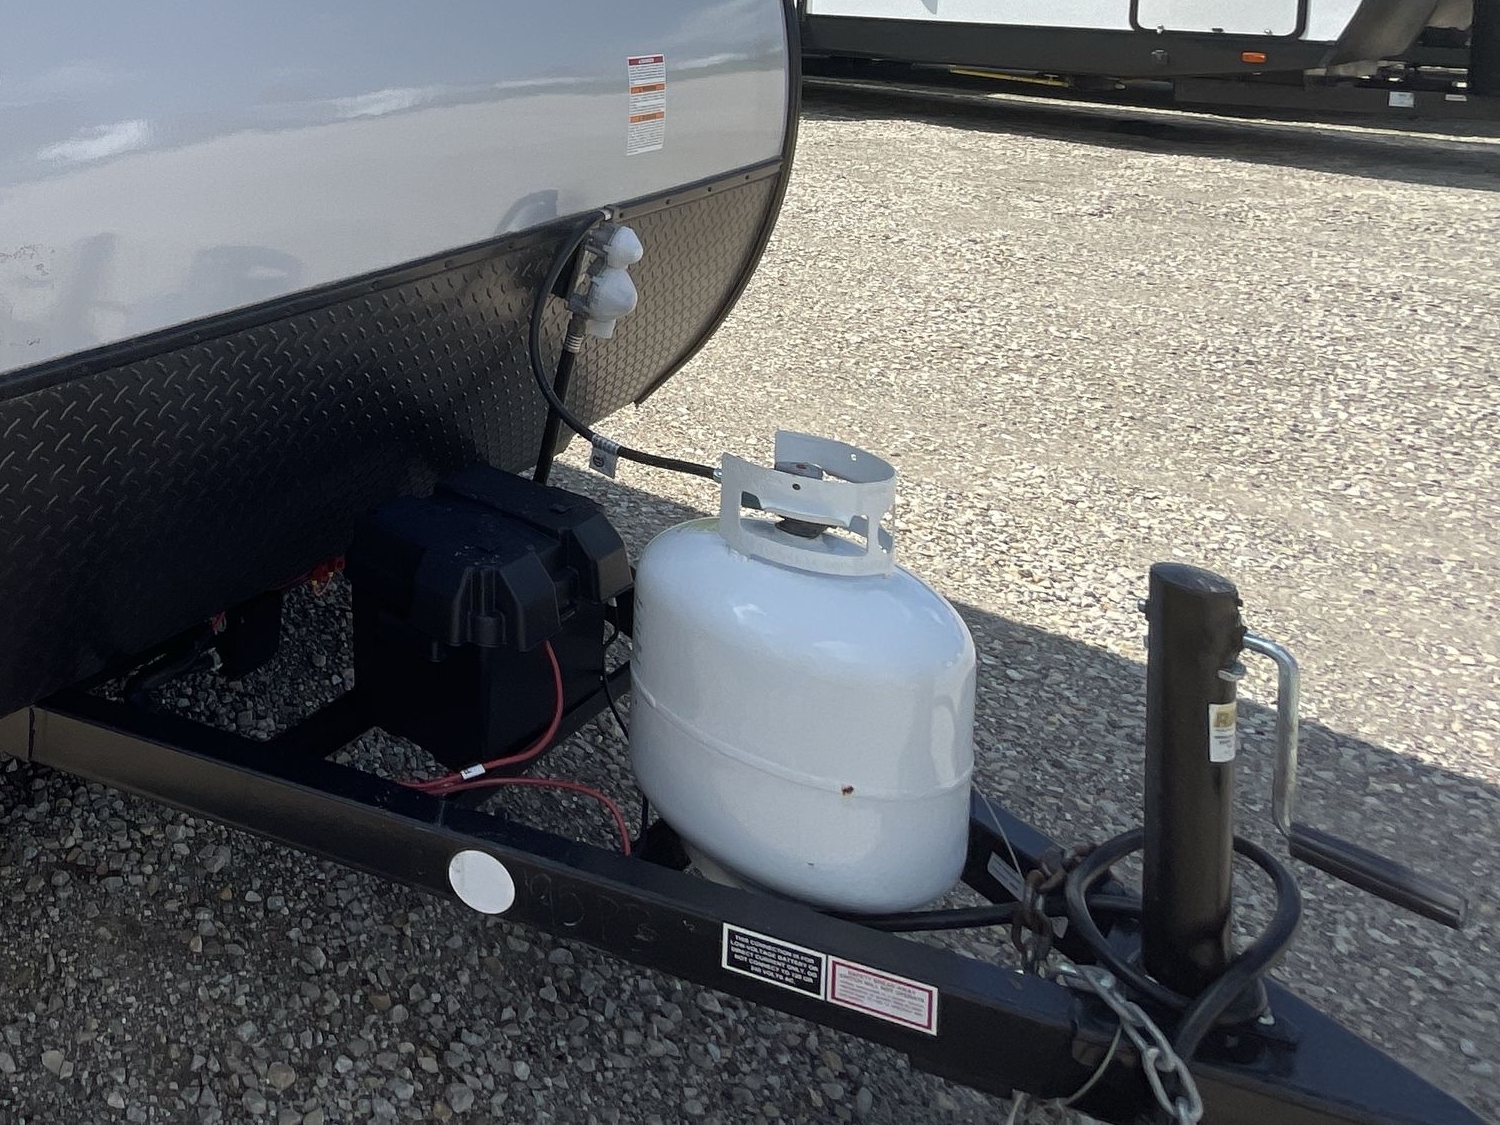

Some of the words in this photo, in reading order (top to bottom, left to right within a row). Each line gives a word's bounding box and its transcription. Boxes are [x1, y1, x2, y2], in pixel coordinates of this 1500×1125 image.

[748, 958, 778, 972] CONNECT
[755, 953, 785, 968] CURRENT
[777, 954, 806, 968] BATTERY
